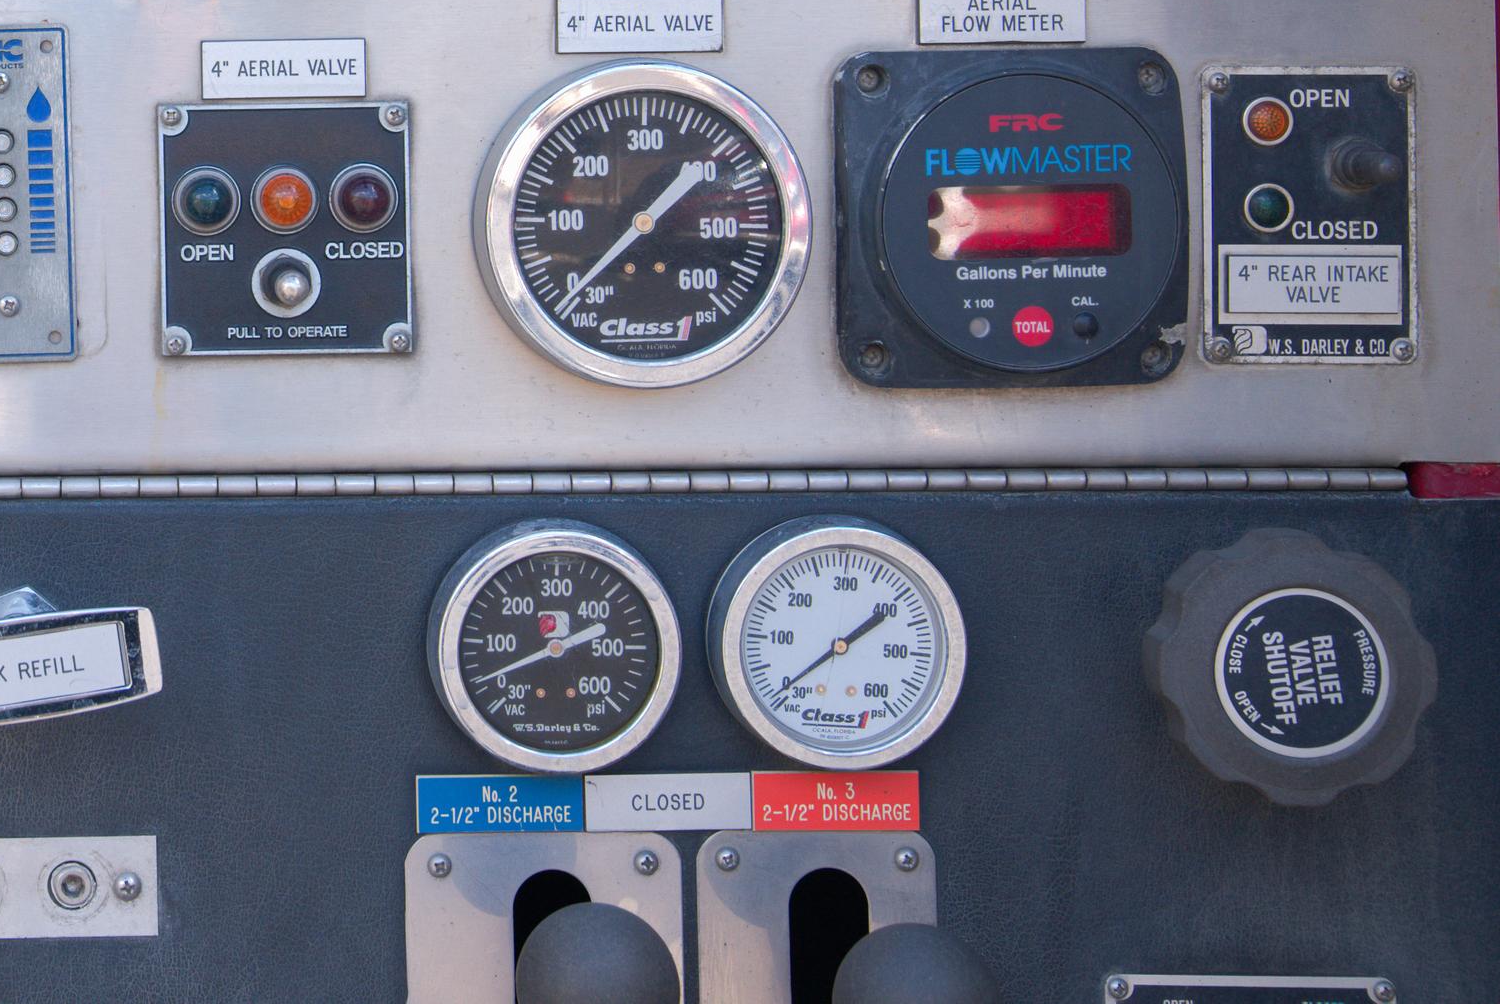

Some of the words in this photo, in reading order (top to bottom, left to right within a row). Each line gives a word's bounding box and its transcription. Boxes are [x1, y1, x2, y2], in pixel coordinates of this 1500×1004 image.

[566, 16, 585, 33] 4"
[593, 15, 655, 32] AERIAL
[664, 15, 713, 31] VALVE
[942, 16, 991, 32] FLOW
[1001, 15, 1064, 32] METER
[211, 60, 229, 77] 4"
[238, 60, 299, 77] AERIAL
[307, 59, 357, 76] VALVE
[1289, 89, 1349, 108] OPEN
[989, 113, 1064, 133] FRC
[626, 129, 663, 149] 300
[925, 143, 1132, 177] FLOWMASTER
[699, 218, 737, 239] 500
[1291, 221, 1378, 240] CLOSED
[180, 244, 234, 261] OPEN
[325, 241, 404, 260] CLOSED
[956, 266, 1017, 281] Gallons
[1021, 265, 1048, 279] Per
[1052, 264, 1107, 279] Minute
[1238, 265, 1258, 282] 4"
[1268, 265, 1316, 282] REAR
[1327, 265, 1389, 282] INTAKE
[963, 299, 971, 309] X
[974, 299, 994, 309] 100
[1071, 297, 1099, 307] CAL.
[1286, 286, 1340, 303] VALVE
[228, 327, 260, 339] PULL
[265, 327, 282, 338] TO
[288, 325, 347, 338] OPERATE
[1015, 321, 1050, 333] TOTAL
[502, 597, 533, 615] 200
[770, 631, 794, 645] 100
[1229, 634, 1248, 674] CLOSE
[1354, 630, 1376, 696] PRESSURE
[18, 655, 85, 679] REFILL
[1288, 640, 1318, 706] VALVE
[1312, 634, 1344, 704] RELIEF
[1262, 632, 1298, 725] SHUTOFF
[1234, 690, 1261, 723] OPEN
[481, 786, 504, 803] No.
[509, 785, 518, 802] 2
[816, 783, 838, 800] No.
[845, 782, 855, 799] 3
[631, 793, 705, 812] CLOSED
[762, 804, 815, 822] 2-1/2"
[822, 802, 912, 821] DISCHARGE
[430, 806, 481, 825] 2-1/2"
[486, 805, 572, 824] DISCHARGE
